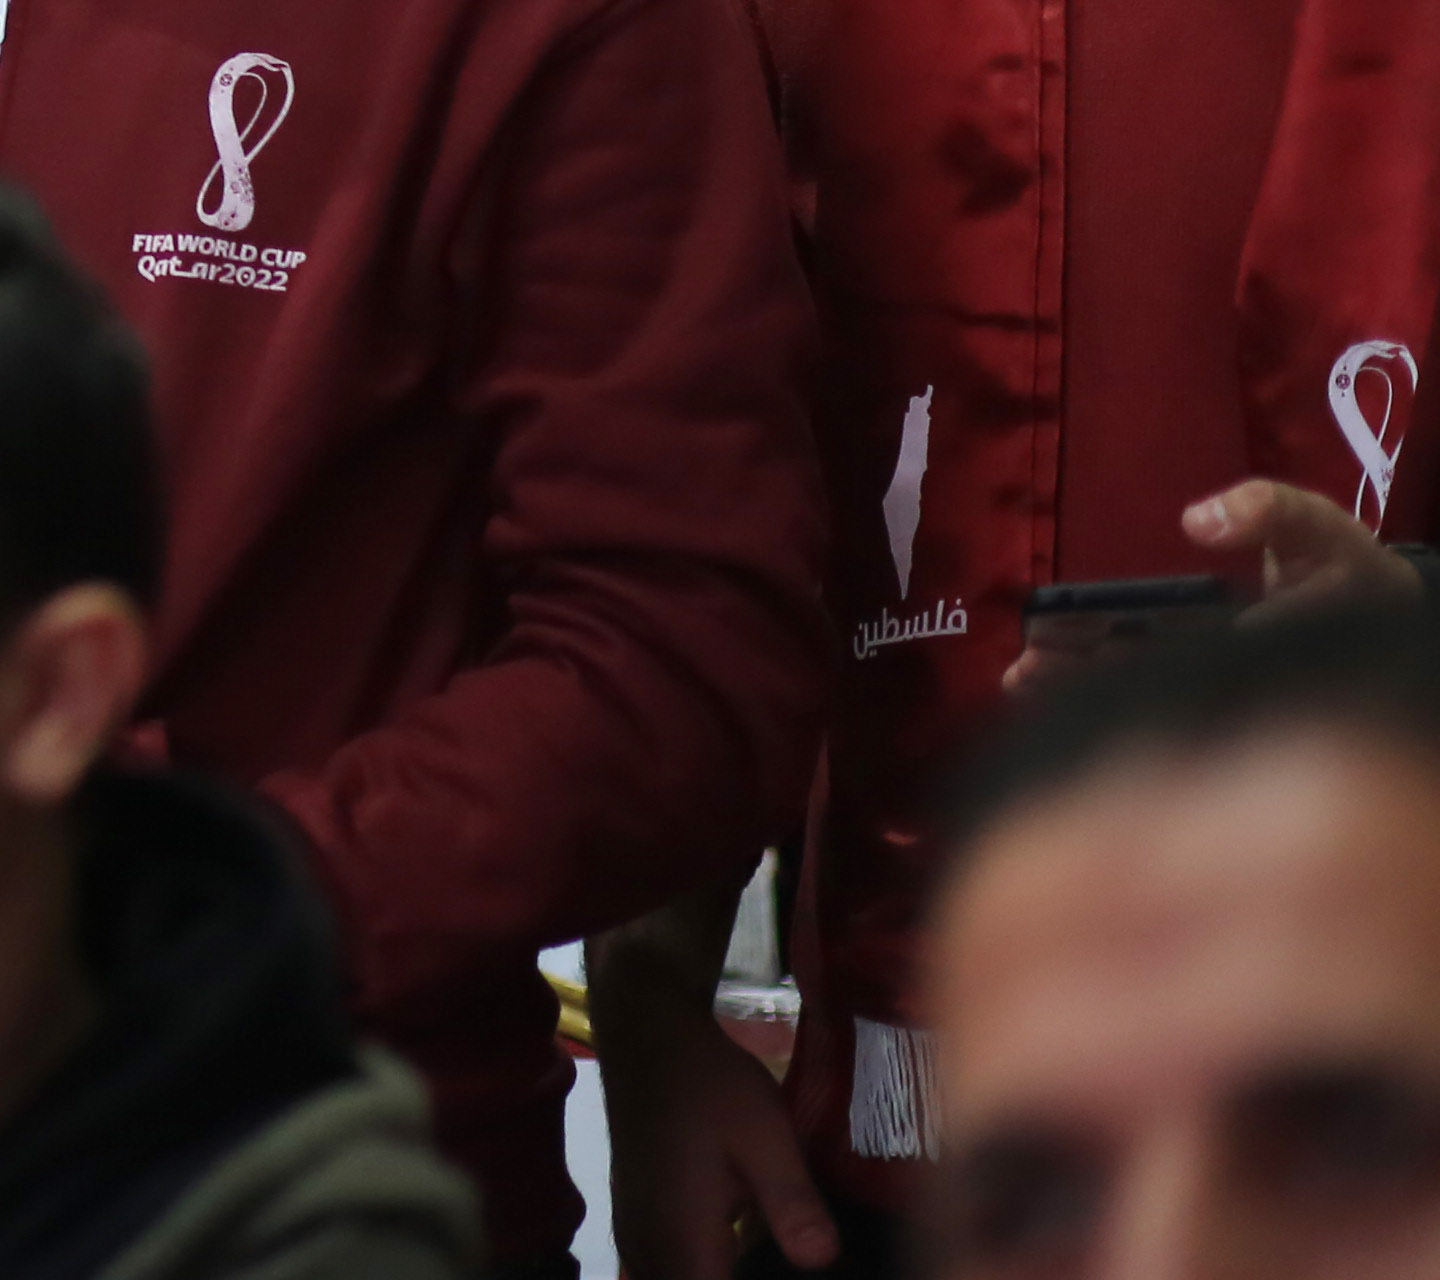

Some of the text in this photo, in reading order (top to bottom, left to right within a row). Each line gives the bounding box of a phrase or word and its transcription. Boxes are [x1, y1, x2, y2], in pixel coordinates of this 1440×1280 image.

[131, 233, 308, 269] FIFA WORLD CUP
[853, 597, 968, 660] فلسطين
